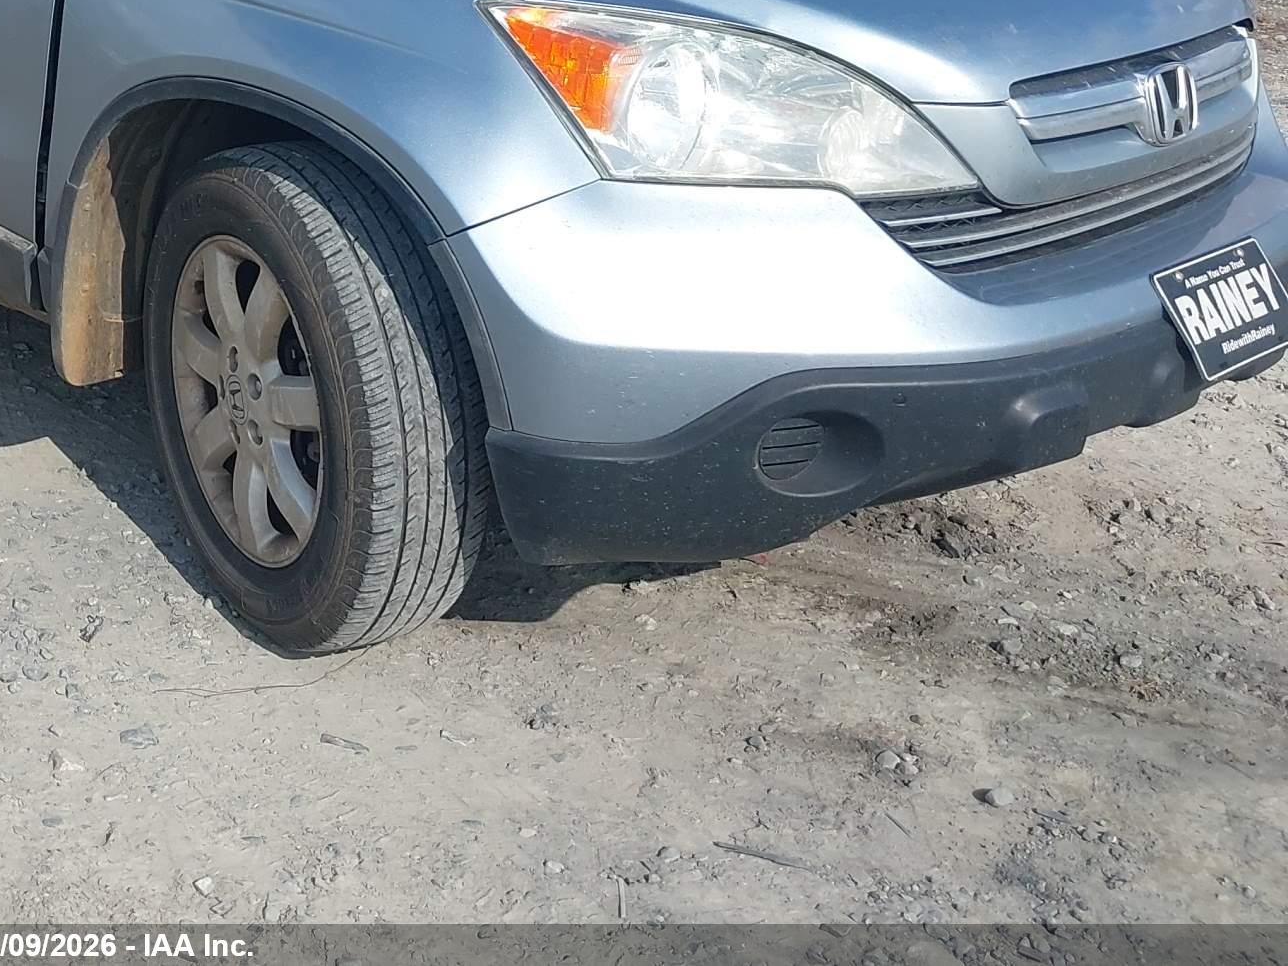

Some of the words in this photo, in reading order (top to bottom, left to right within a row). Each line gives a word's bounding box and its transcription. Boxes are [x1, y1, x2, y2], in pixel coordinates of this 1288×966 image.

[1184, 278, 1191, 289] A
[1190, 274, 1208, 285] Name
[1207, 269, 1219, 278] You
[1219, 265, 1231, 275] Can
[1230, 258, 1245, 269] Trust
[1174, 263, 1280, 345] RAINEY
